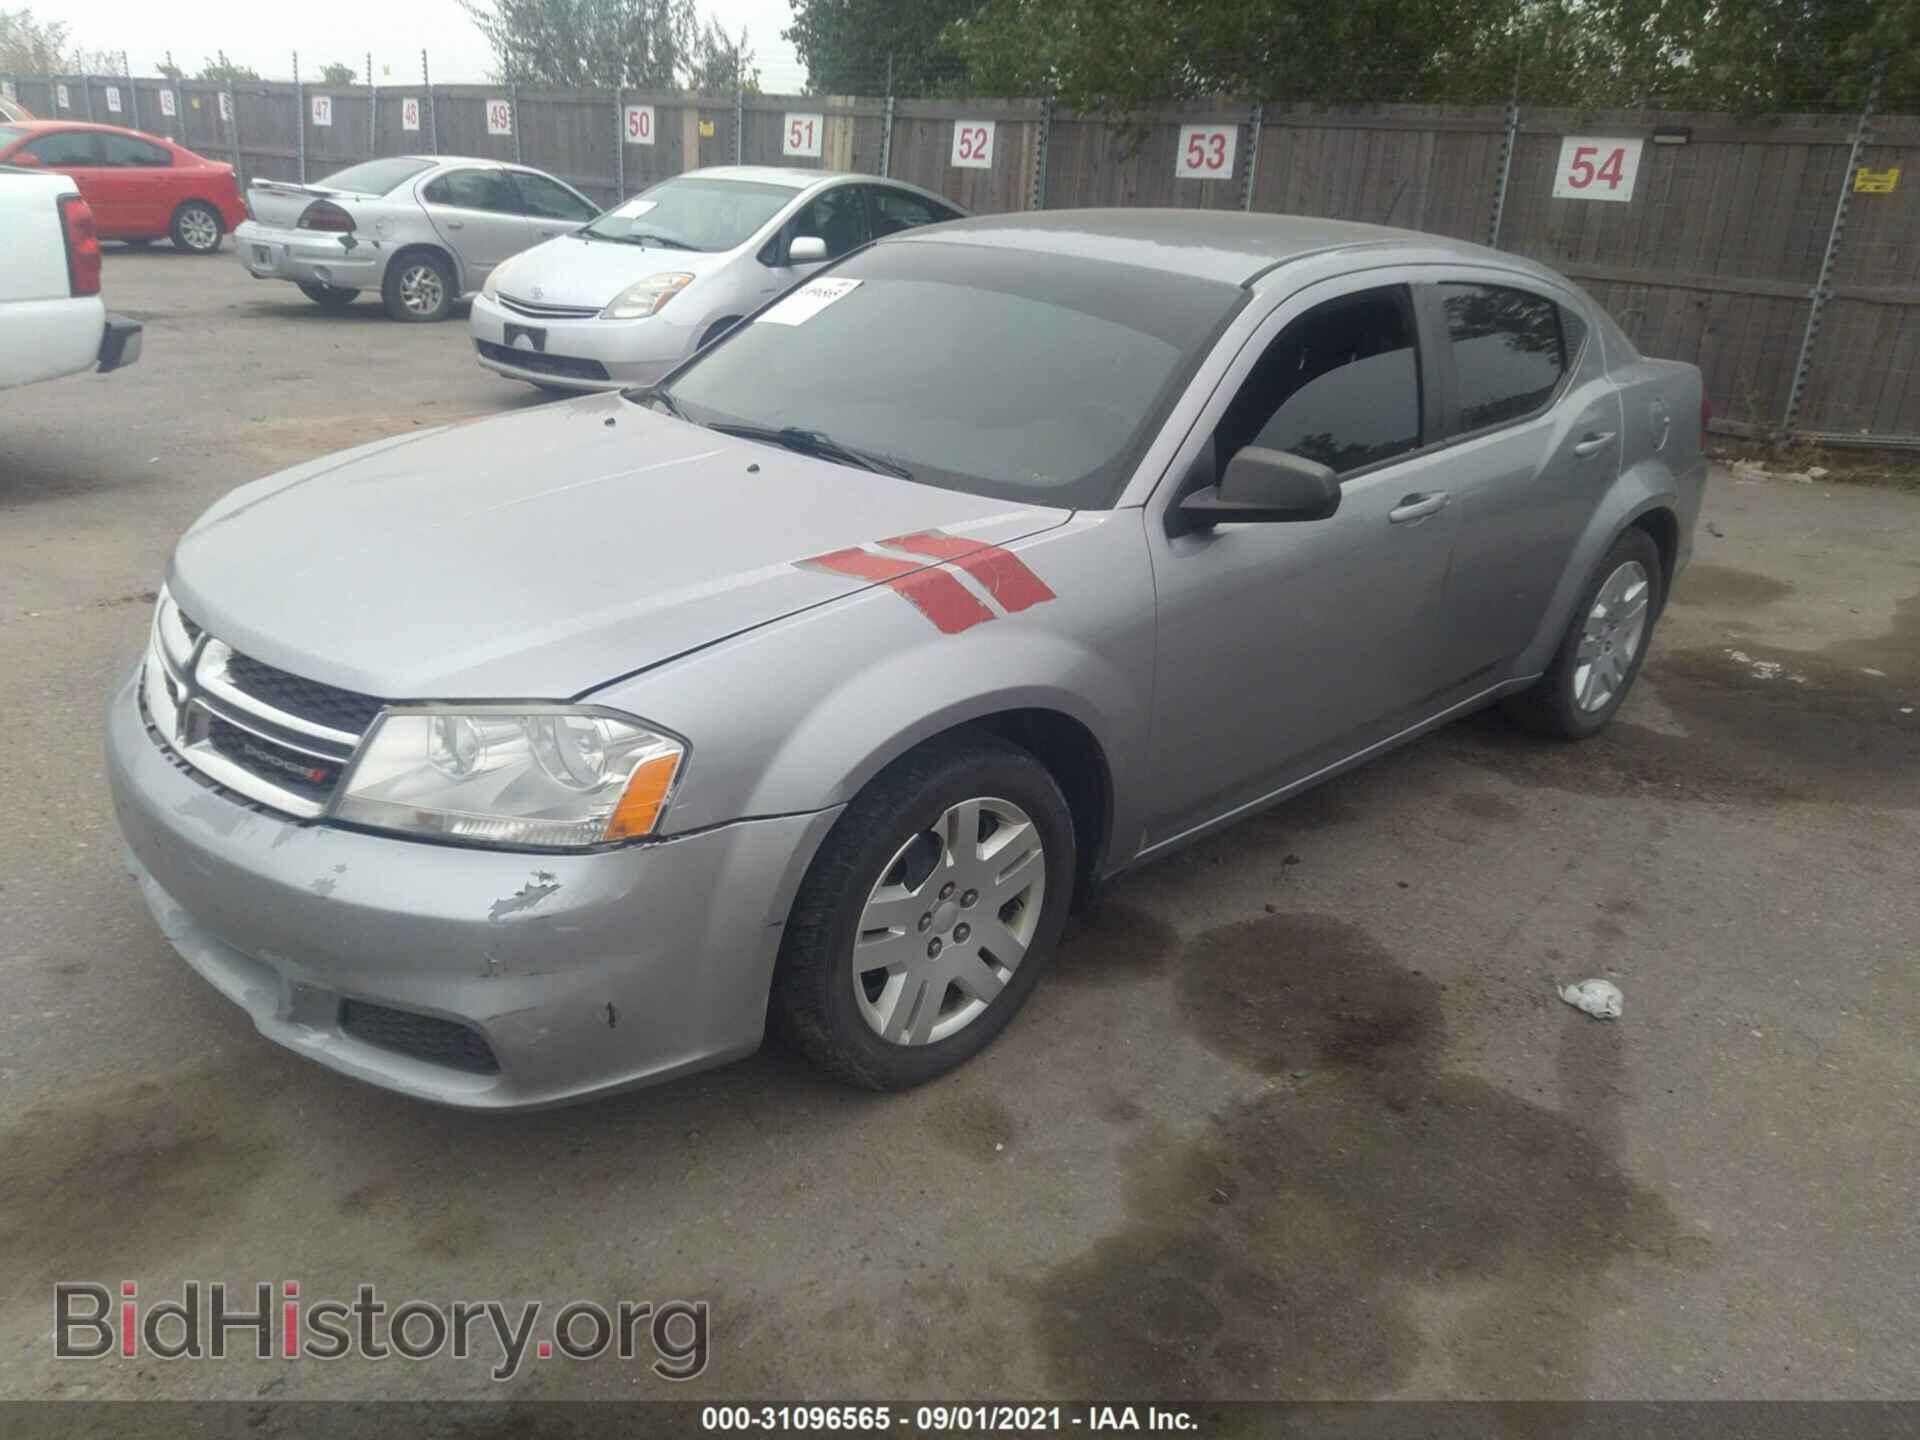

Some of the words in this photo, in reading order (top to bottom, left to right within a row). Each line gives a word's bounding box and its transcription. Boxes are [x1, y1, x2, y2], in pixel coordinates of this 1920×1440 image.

[405, 104, 416, 125] 48
[491, 105, 507, 129] 49
[629, 112, 650, 137] 50
[790, 120, 814, 149] 51
[959, 128, 988, 159] 52
[1186, 133, 1226, 170] 53
[1568, 147, 1625, 190] 54
